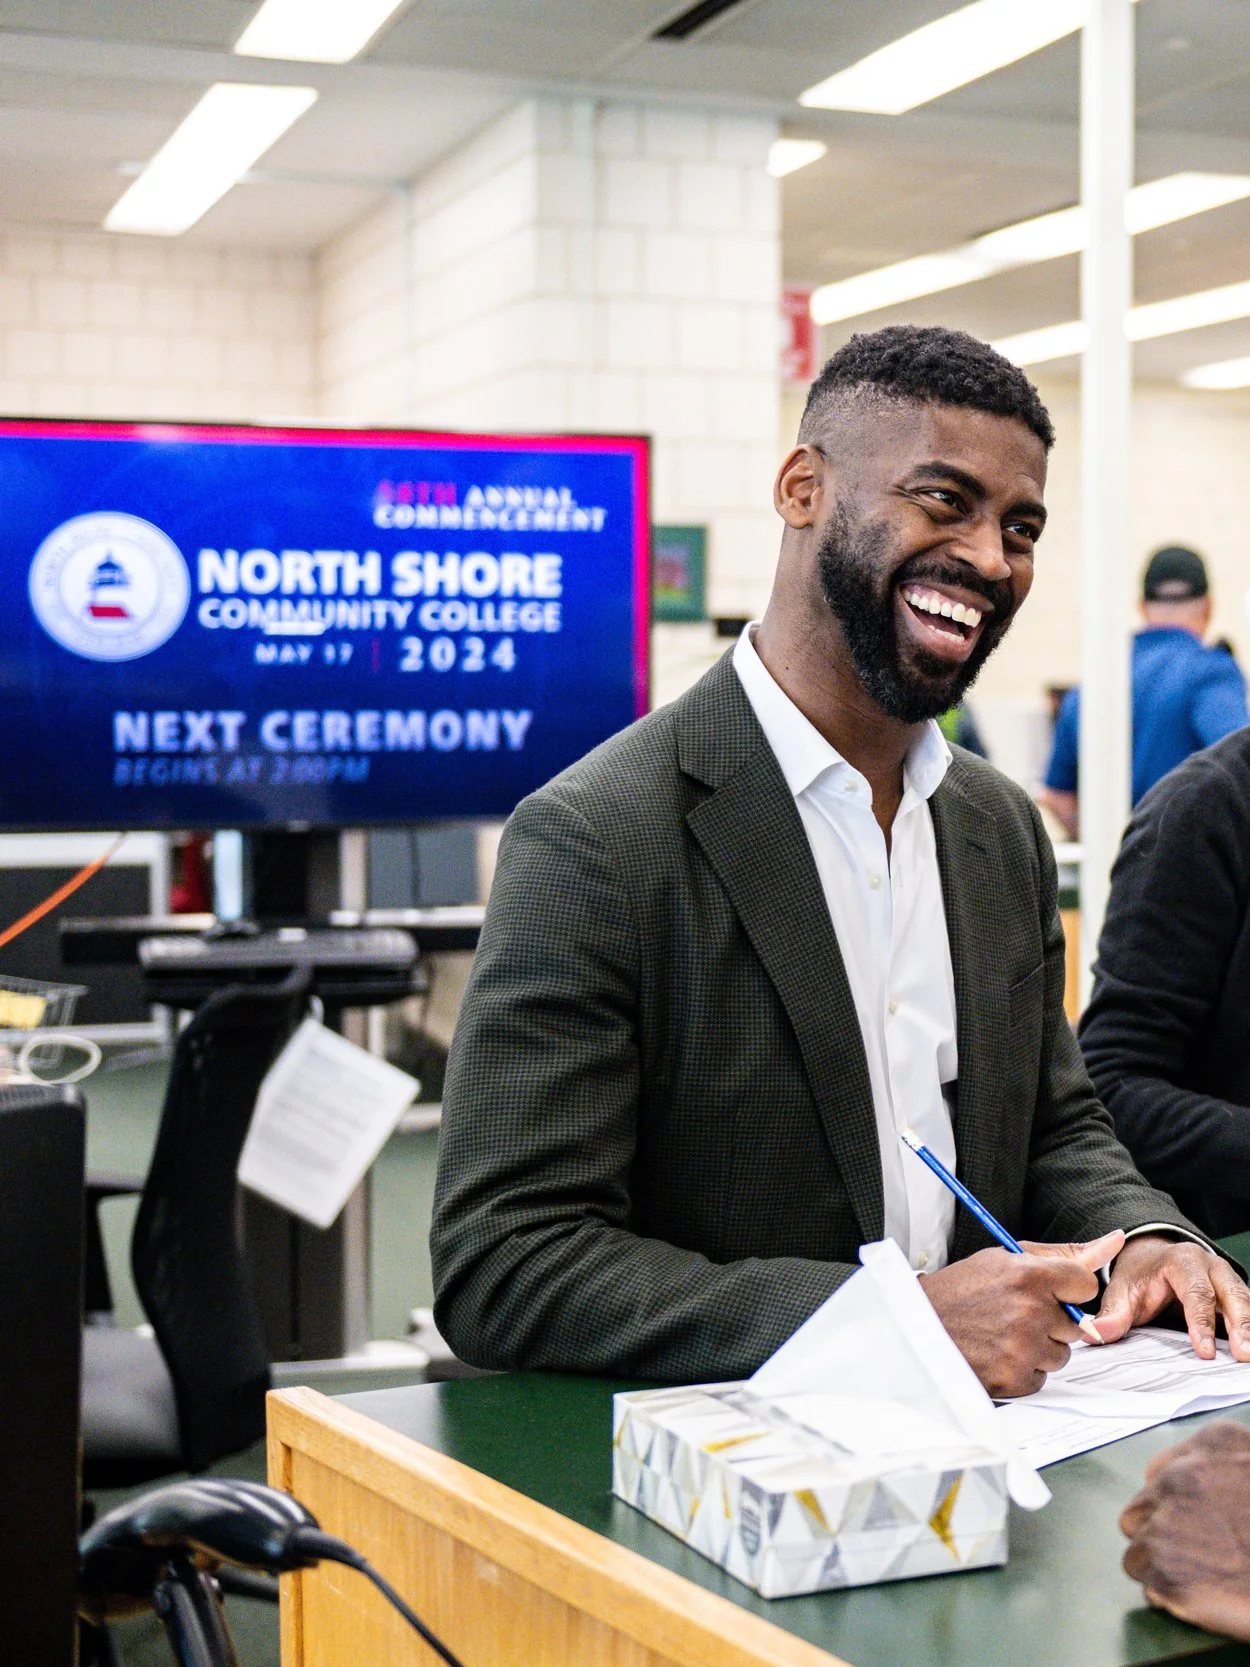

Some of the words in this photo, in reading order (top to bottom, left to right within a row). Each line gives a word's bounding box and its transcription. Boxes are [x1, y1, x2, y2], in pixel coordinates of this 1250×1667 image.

[464, 485, 577, 508] ANNUAL
[373, 505, 608, 531] COMMENCEMENT
[198, 549, 382, 596] NORTH
[391, 551, 563, 599] SHORE
[198, 598, 415, 632] COMMUNITY
[418, 601, 562, 633] COLLEGE
[254, 643, 313, 665] MAY
[323, 643, 354, 665] 17
[399, 636, 517, 672] 2024
[113, 710, 246, 752] NEXT
[259, 710, 533, 752] CEREMONY
[113, 756, 219, 786] BEGINS
[226, 756, 263, 785] AT
